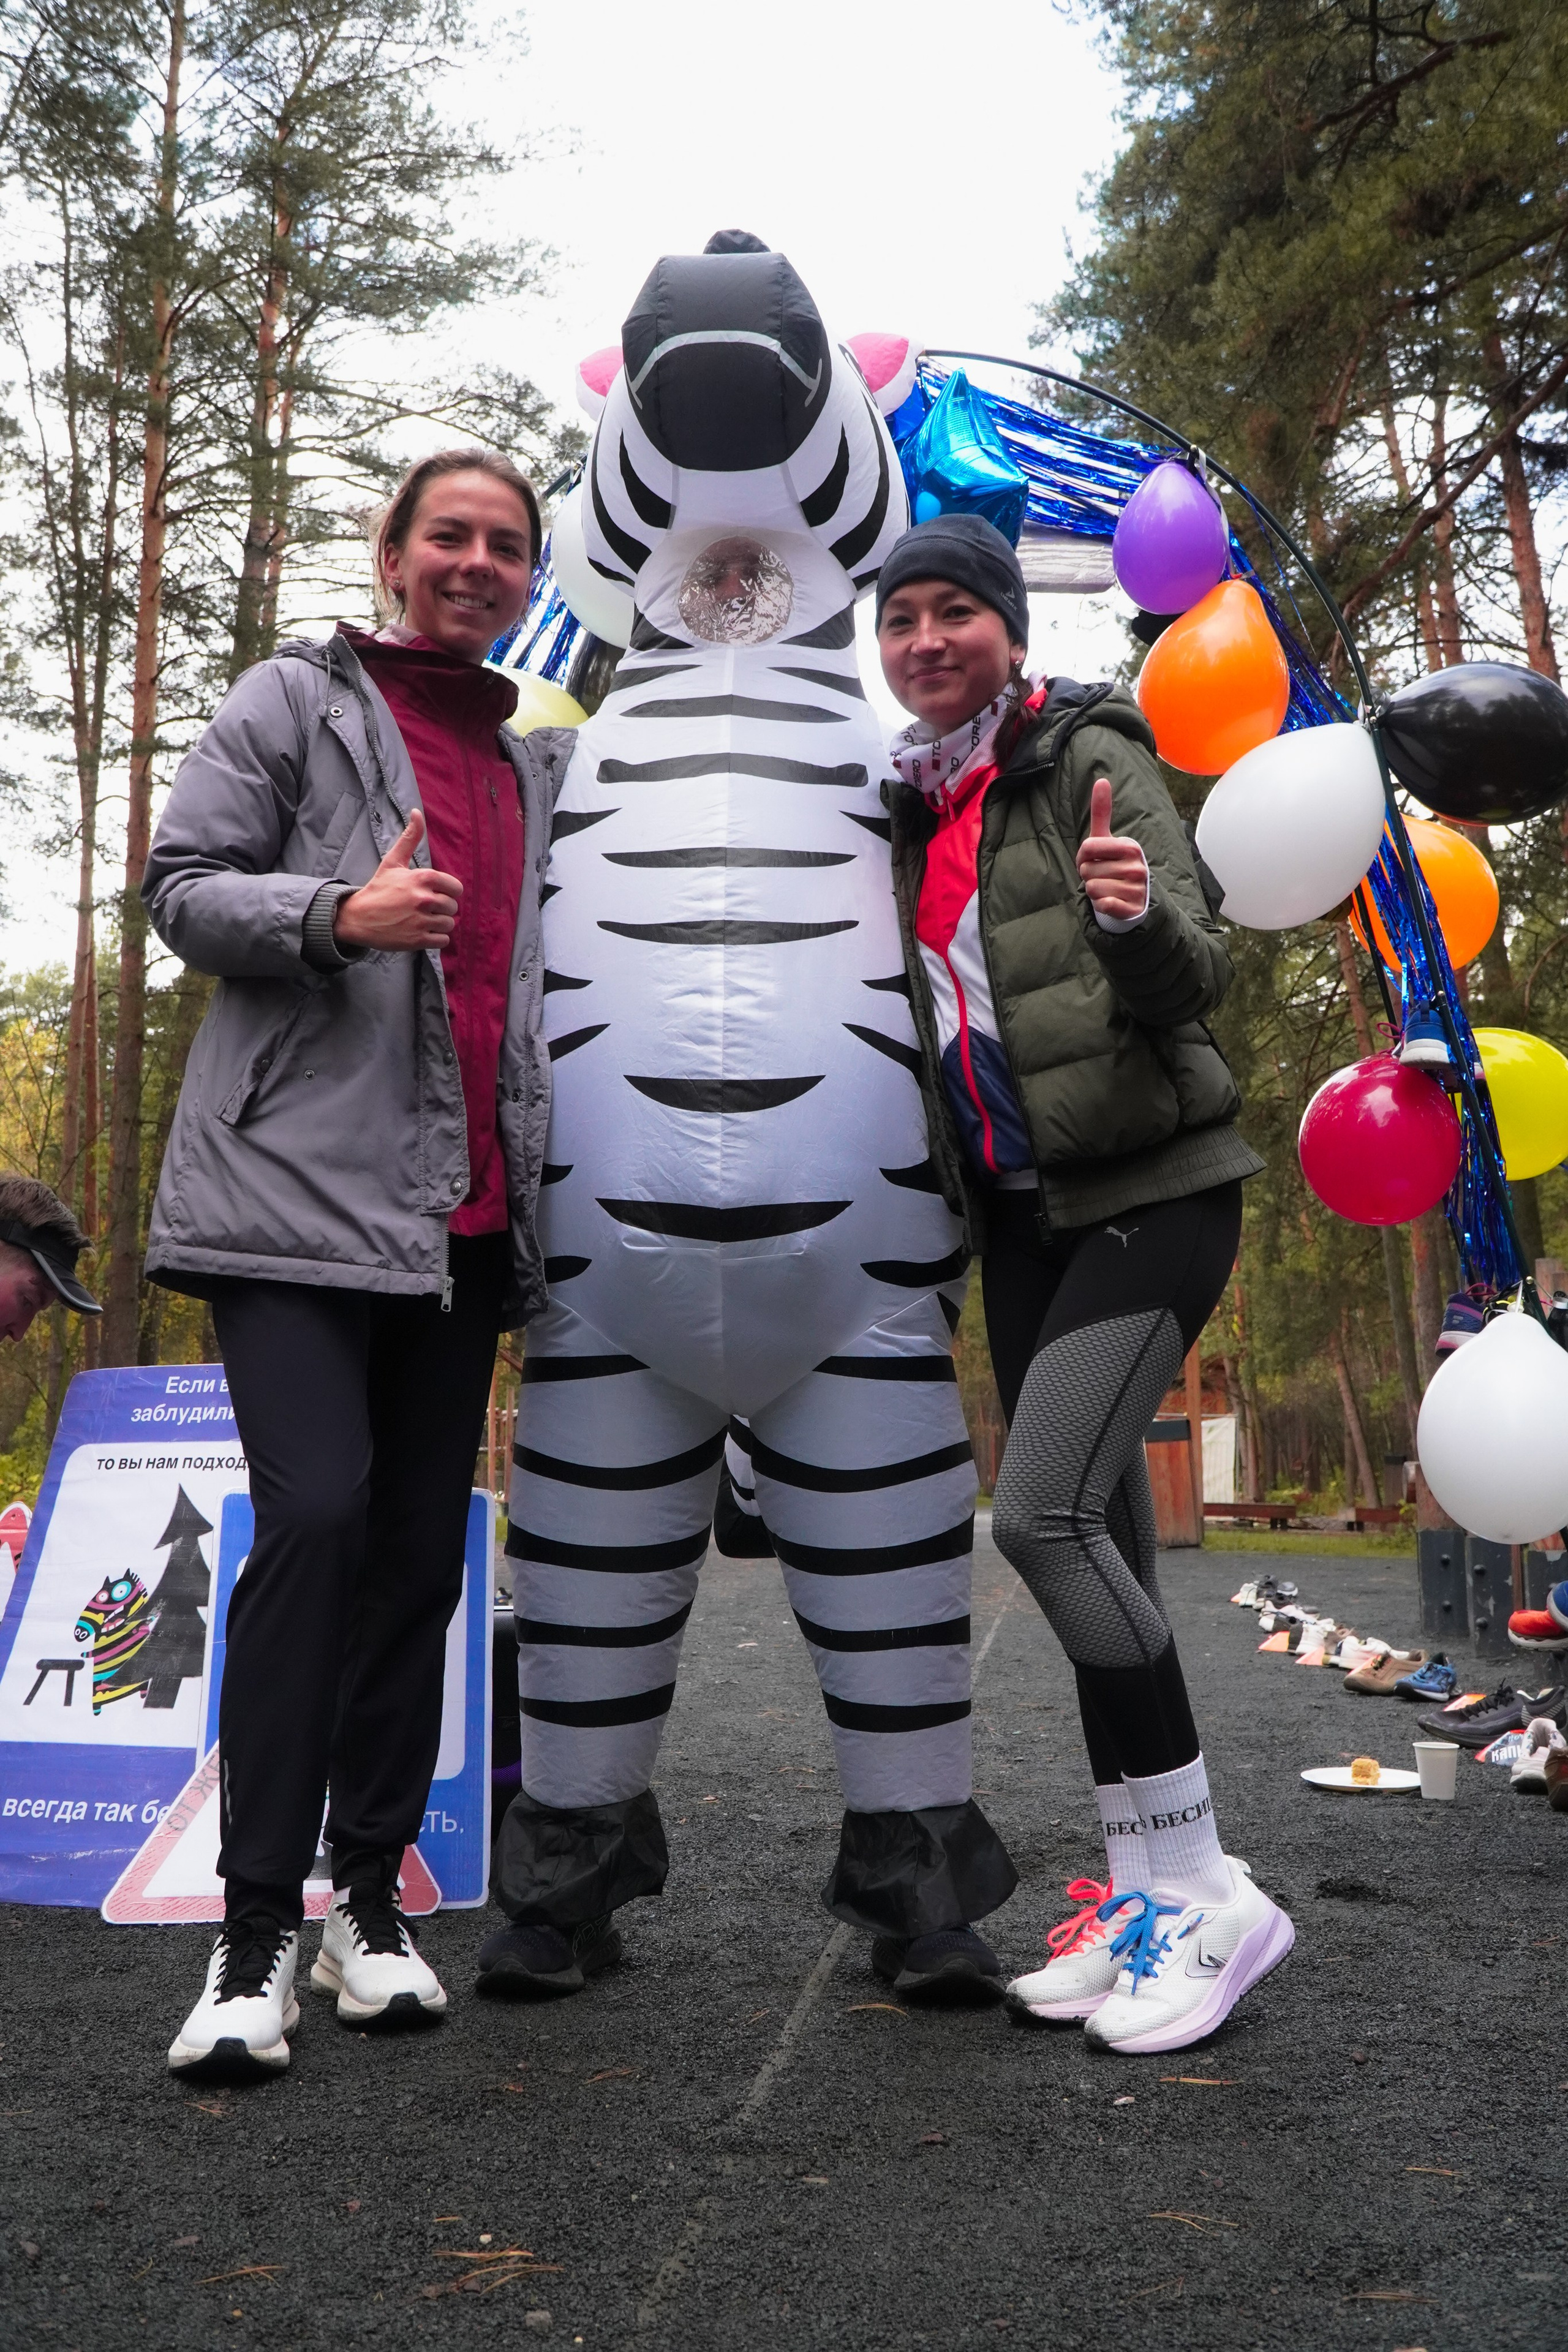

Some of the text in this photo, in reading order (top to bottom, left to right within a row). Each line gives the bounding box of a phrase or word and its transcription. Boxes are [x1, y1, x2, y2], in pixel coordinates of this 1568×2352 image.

[165, 1376, 216, 1393] Если
[97, 1457, 249, 1471] то вы нам подход
[2, 1798, 88, 1823] всегда
[94, 1803, 138, 1823] так
